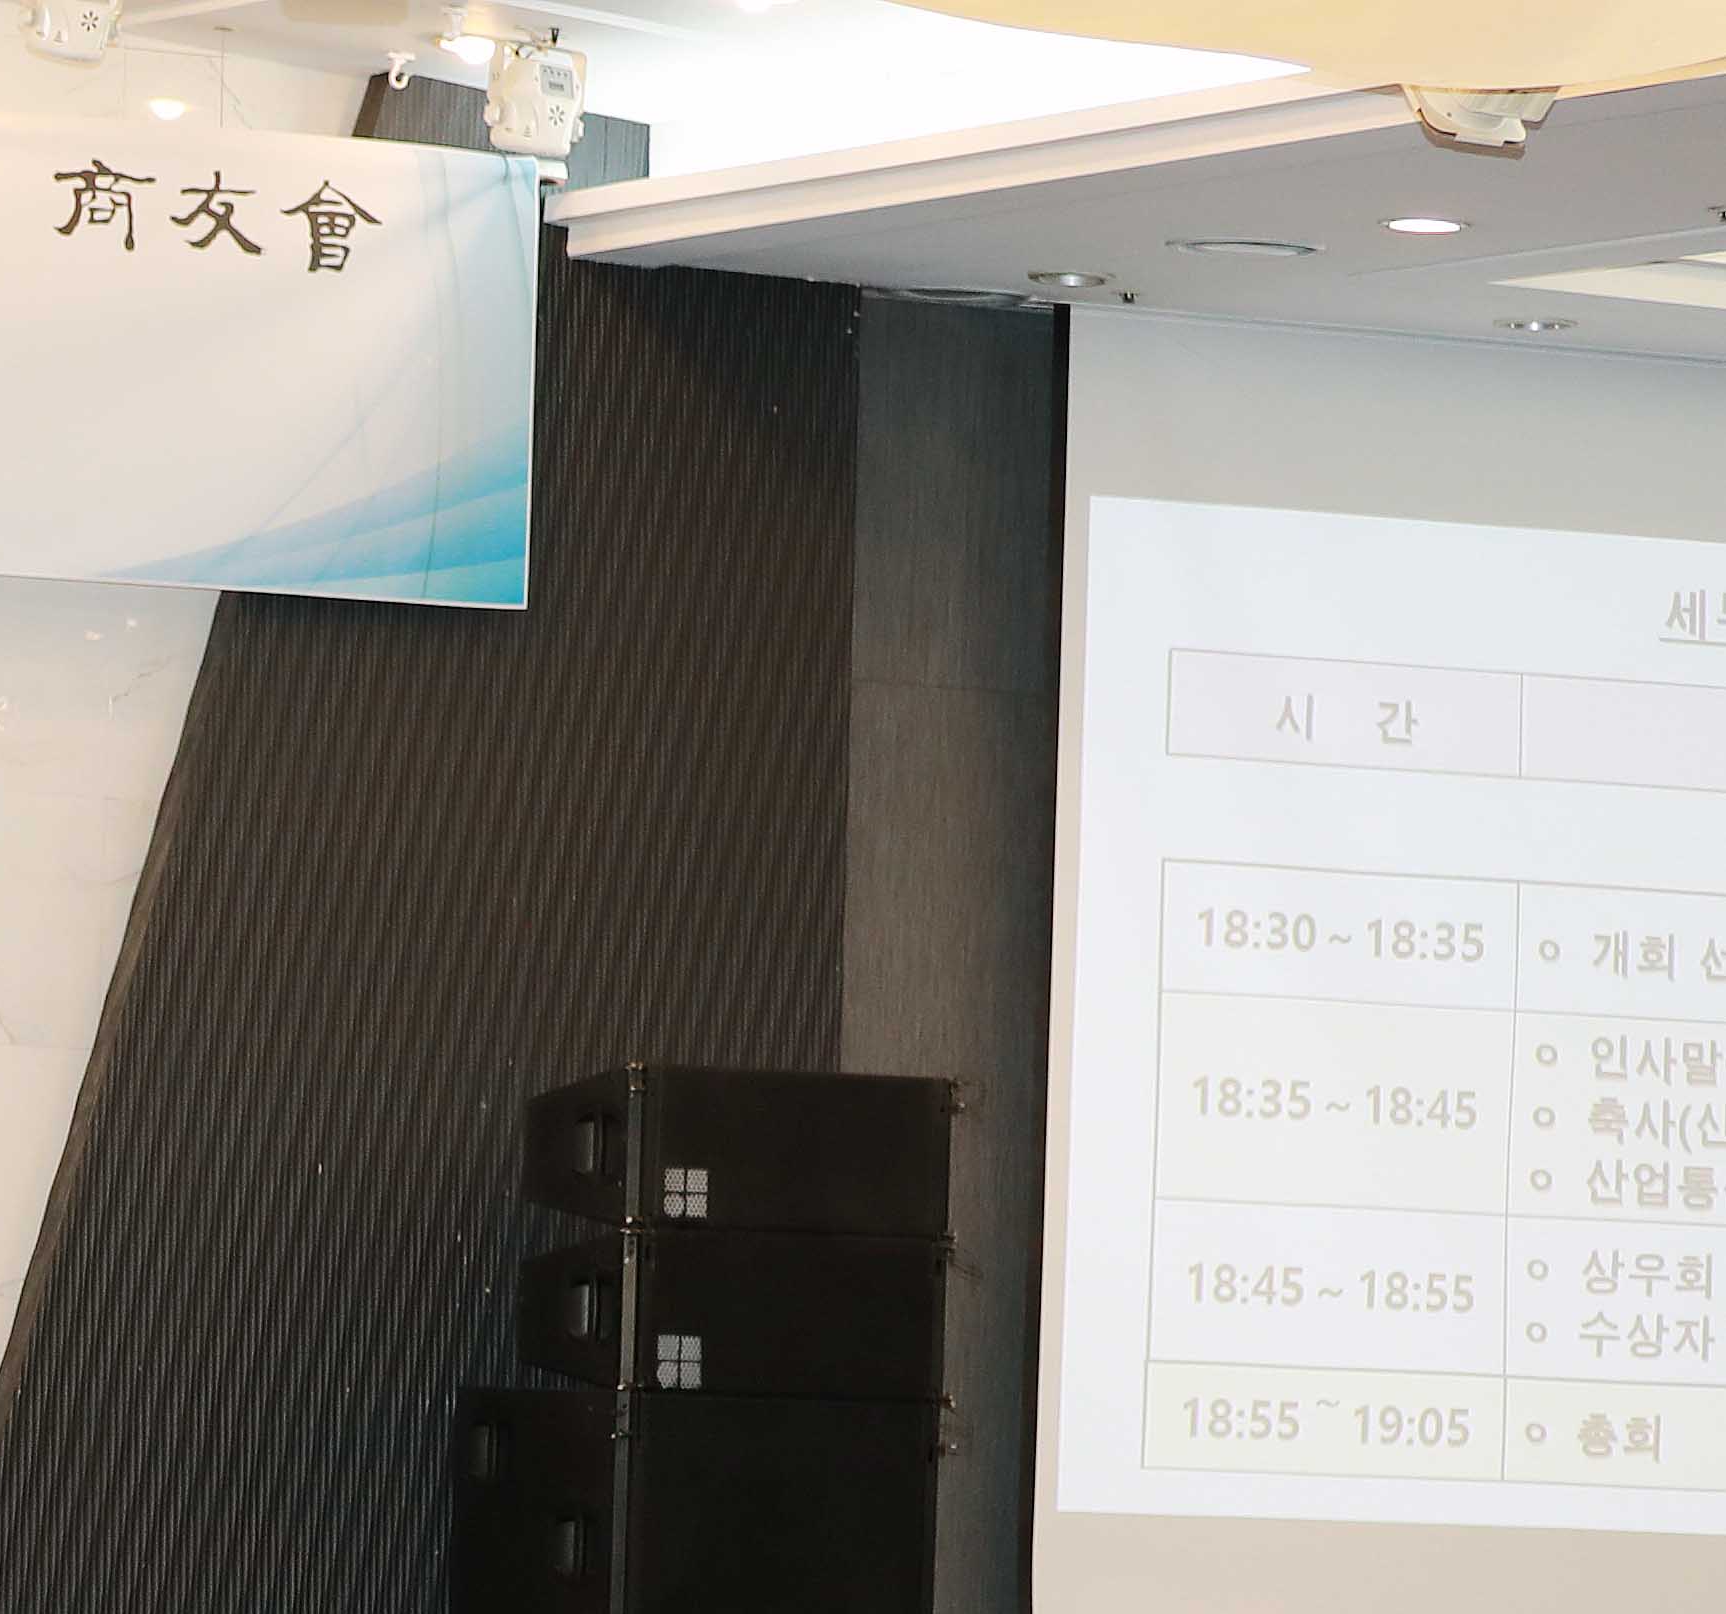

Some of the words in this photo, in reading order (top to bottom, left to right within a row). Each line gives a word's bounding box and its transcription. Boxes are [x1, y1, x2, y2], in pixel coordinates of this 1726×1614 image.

[1592, 929, 1675, 983] 개회
[1586, 1159, 1726, 1211] 산업통
[1582, 1248, 1713, 1301] 상우회
[1579, 1311, 1716, 1363] 수상자
[1576, 1412, 1661, 1465] 총회
